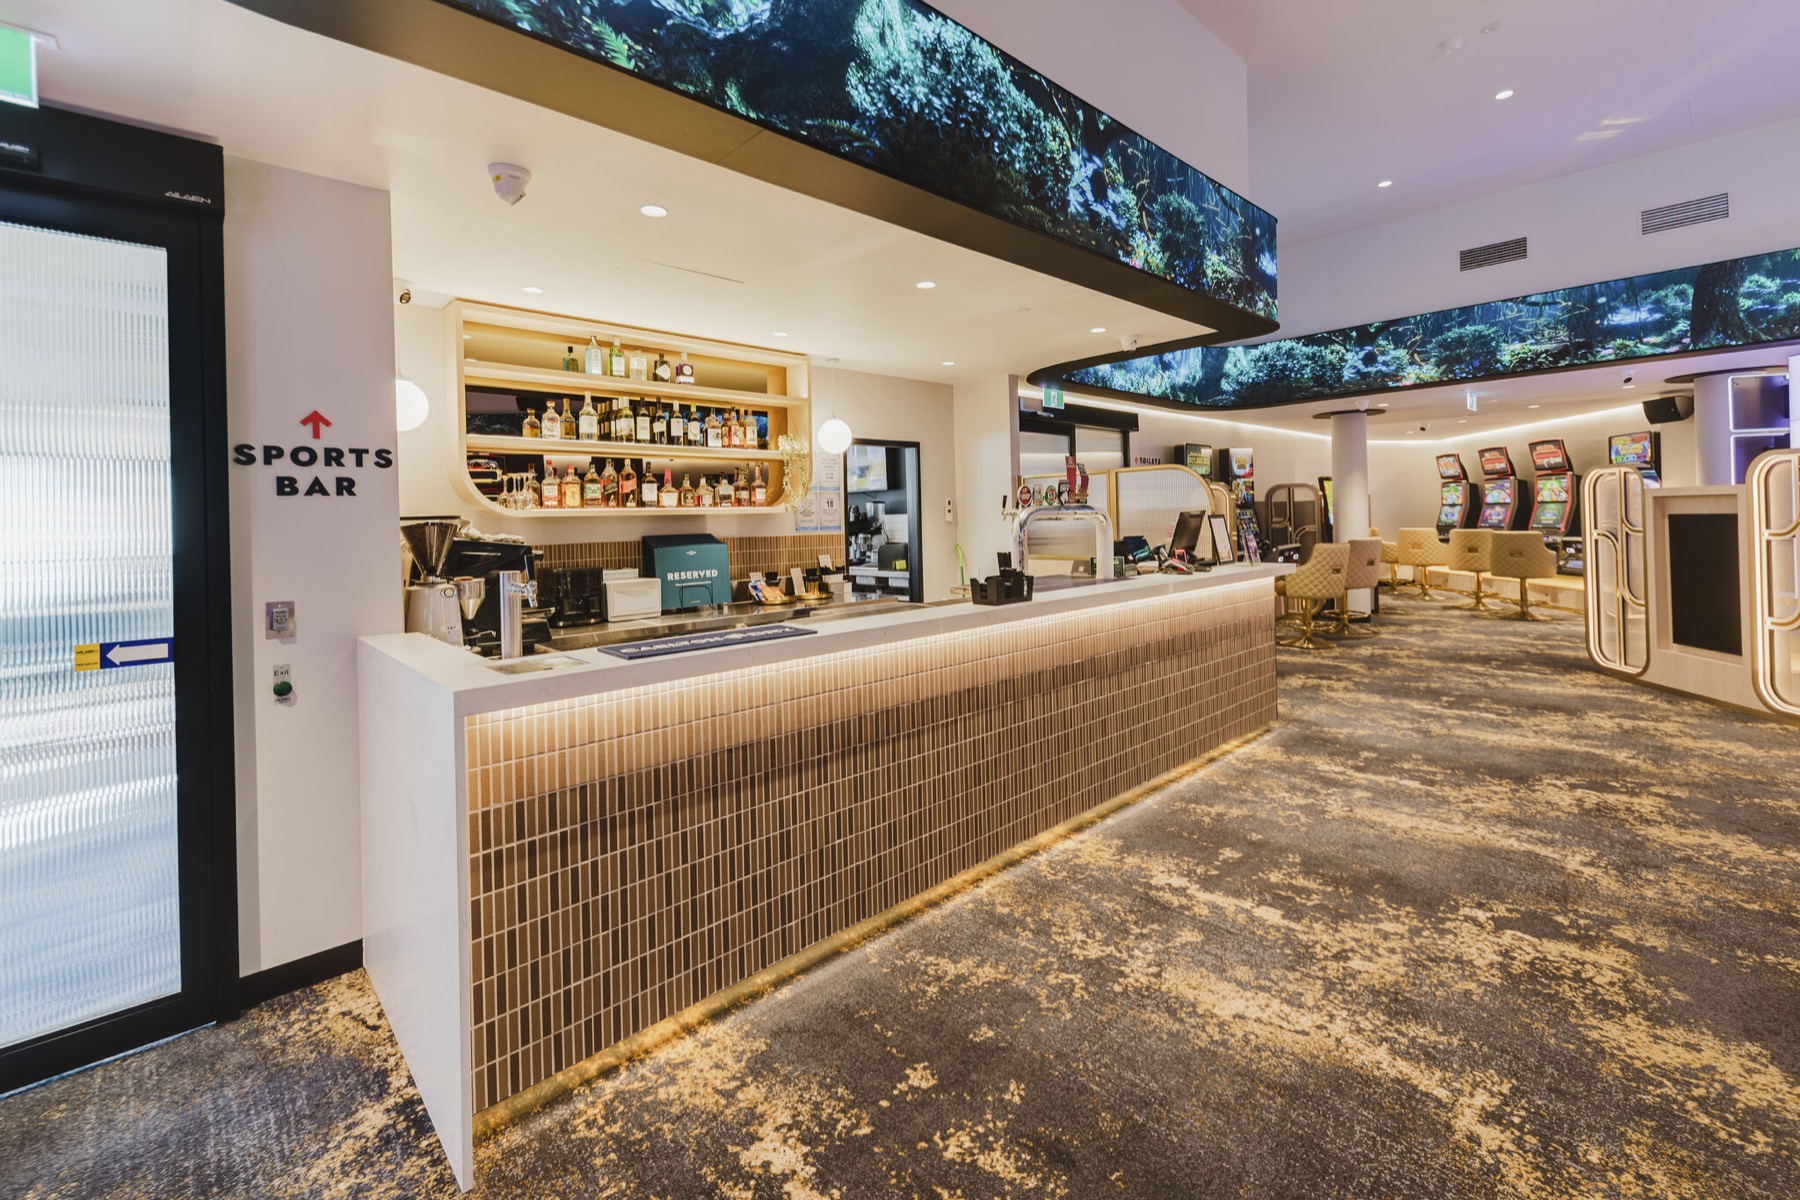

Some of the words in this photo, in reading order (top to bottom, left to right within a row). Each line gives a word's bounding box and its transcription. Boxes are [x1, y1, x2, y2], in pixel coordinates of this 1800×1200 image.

[233, 444, 393, 468] SPORTS
[1139, 456, 1161, 465] TOILETS
[276, 475, 357, 496] BAR
[826, 500, 834, 508] 18
[667, 569, 718, 581] RESERVED
[274, 669, 289, 677] Exit
